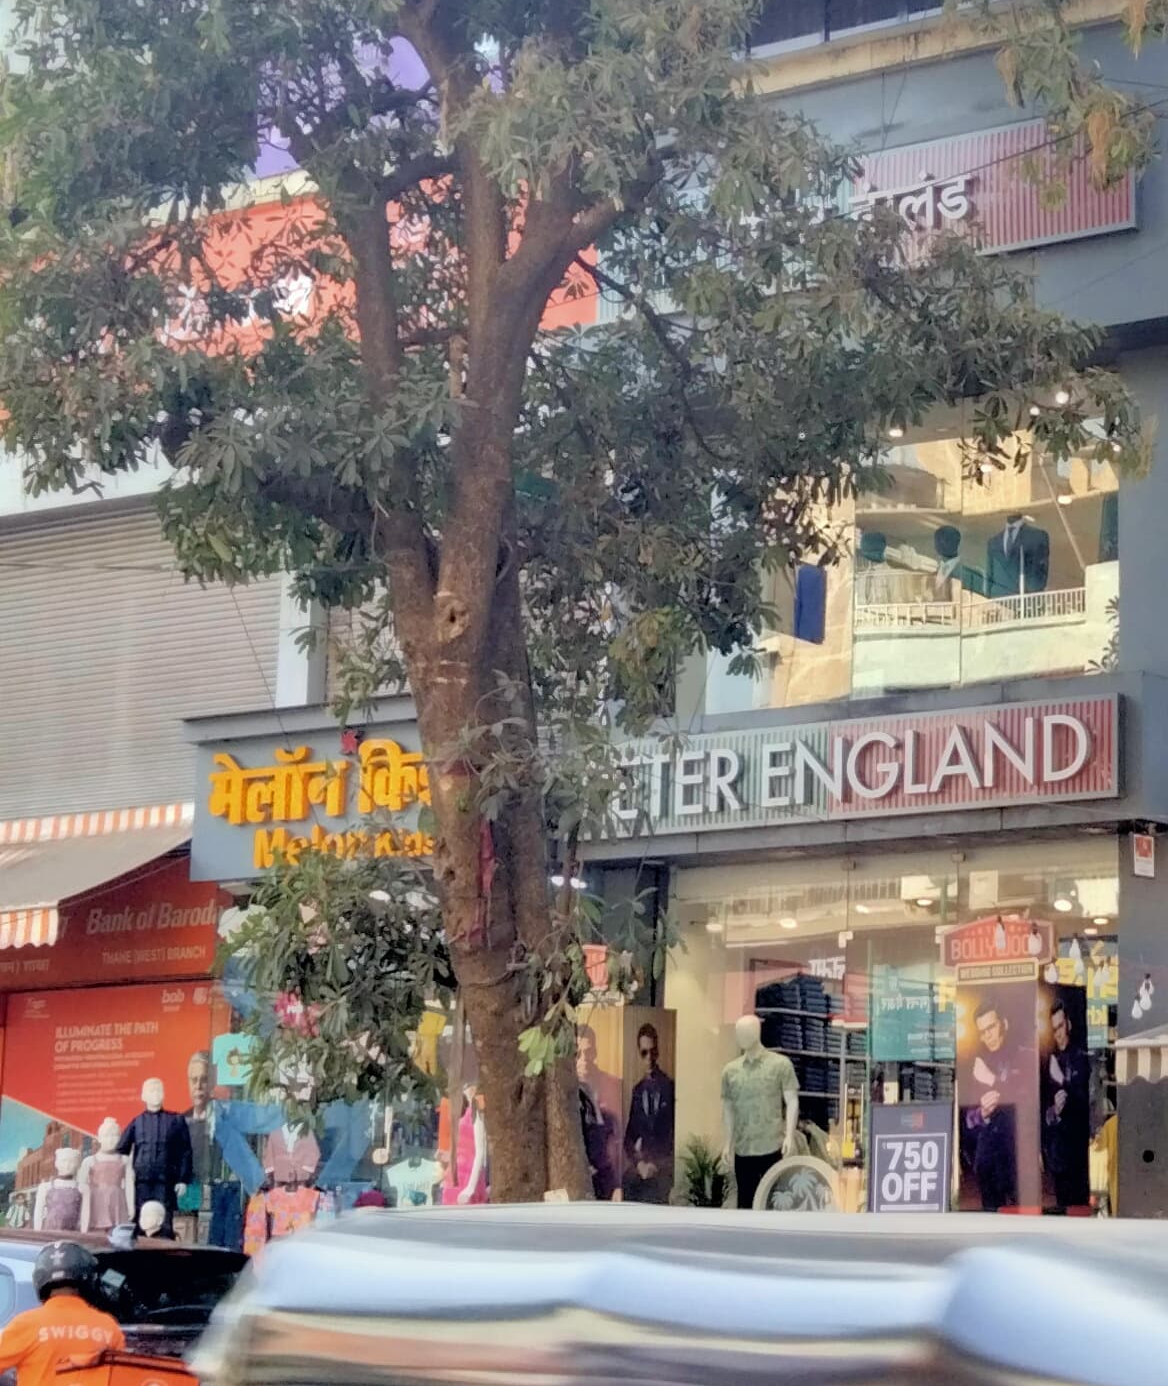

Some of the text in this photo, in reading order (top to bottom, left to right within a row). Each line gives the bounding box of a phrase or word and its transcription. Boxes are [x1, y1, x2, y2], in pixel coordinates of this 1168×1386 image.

[761, 714, 1089, 809] ENGLAND
[86, 907, 132, 934] Bank
[136, 904, 156, 931] of
[56, 1021, 159, 1039] ILLUMINATE THE PATH
[55, 1038, 123, 1053] OF PROGRESS
[881, 1171, 939, 1202] OFF
[39, 1325, 113, 1344] SWIGGY
